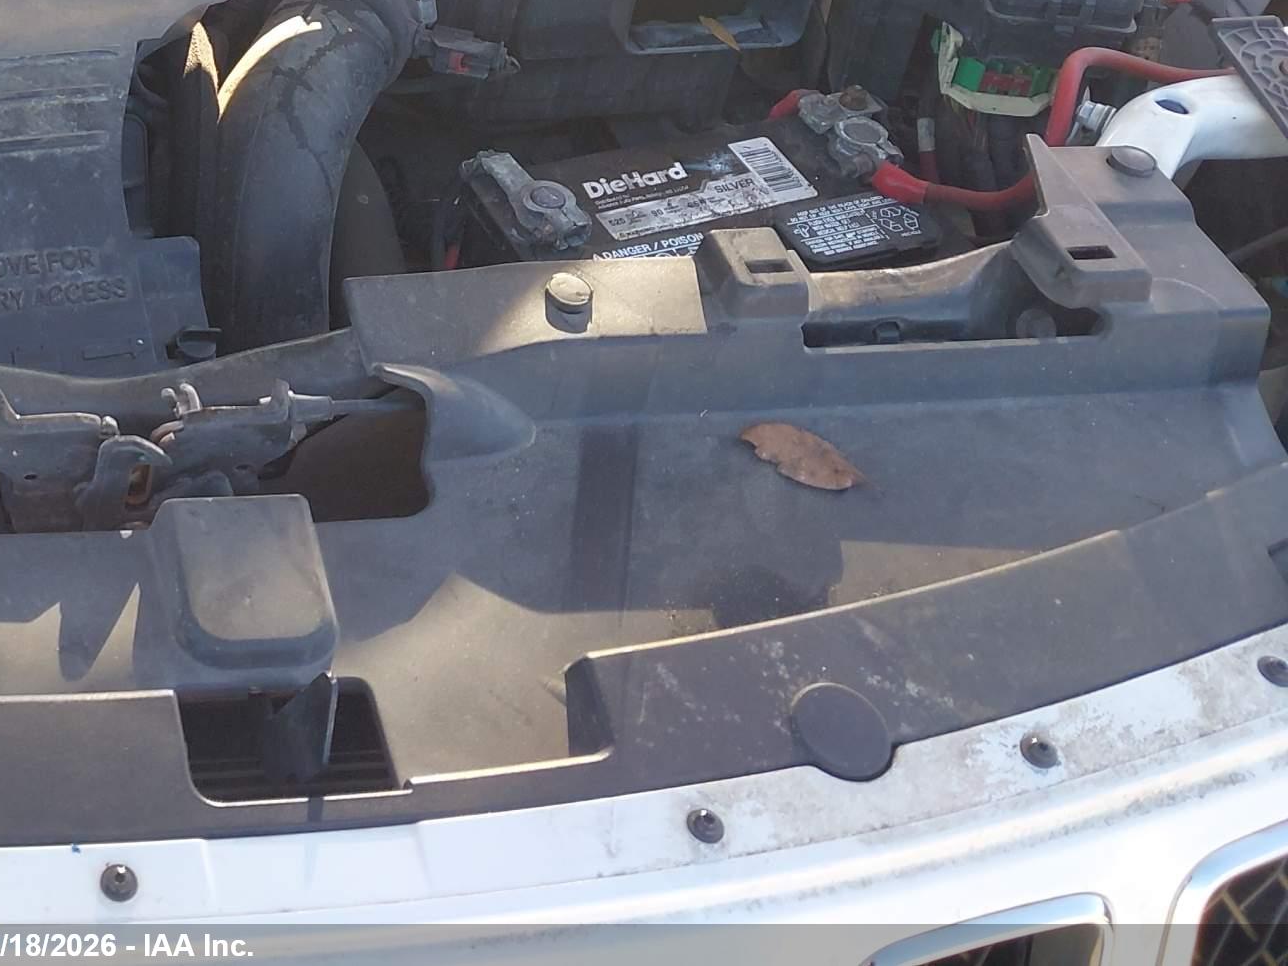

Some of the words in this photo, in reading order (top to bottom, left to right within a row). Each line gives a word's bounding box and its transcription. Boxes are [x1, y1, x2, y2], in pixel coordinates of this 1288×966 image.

[583, 161, 688, 199] DieHard
[714, 178, 755, 194] SILVER
[601, 242, 652, 260] DANGER
[659, 232, 704, 248] POISON
[44, 247, 95, 274] FOR
[33, 277, 127, 307] ACCESS
